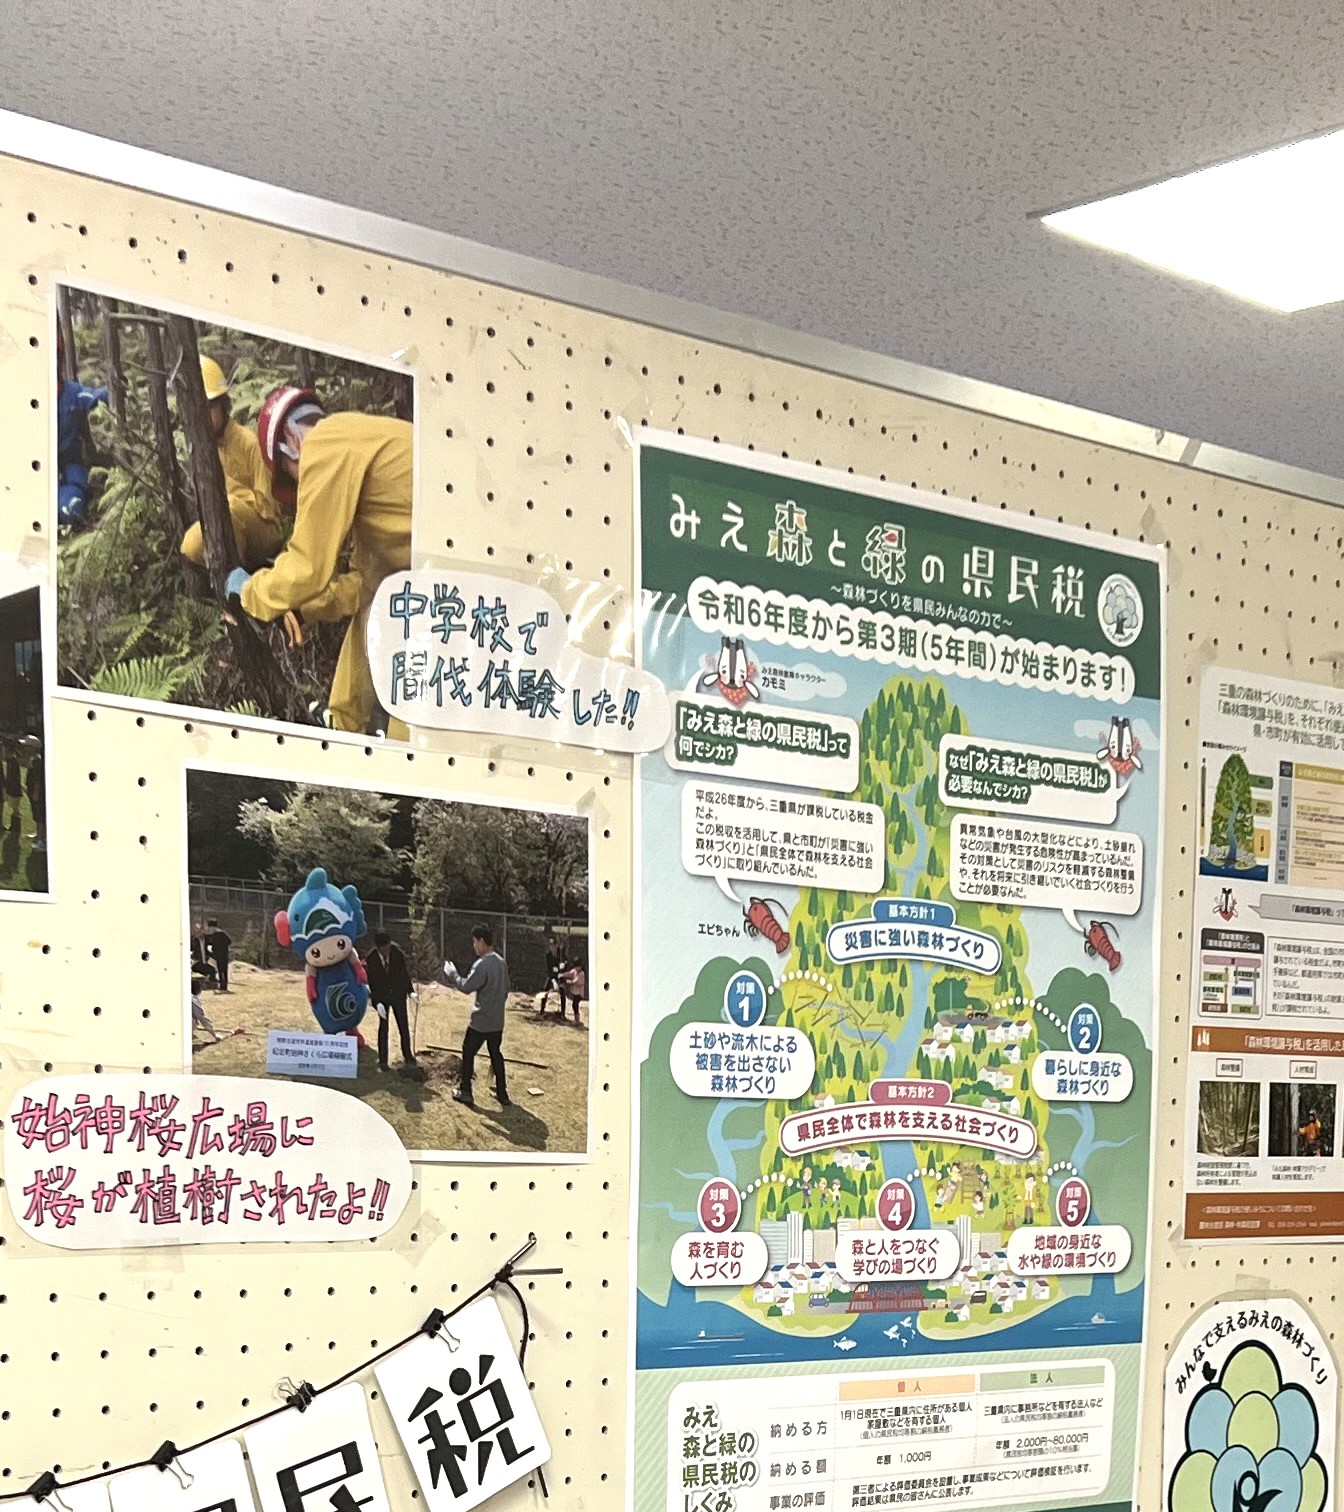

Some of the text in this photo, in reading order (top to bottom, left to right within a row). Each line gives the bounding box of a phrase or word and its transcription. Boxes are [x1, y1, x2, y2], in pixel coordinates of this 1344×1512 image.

[670, 494, 1087, 618] みえ森と緑の県民税
[390, 581, 548, 655] 中学校で
[679, 706, 847, 753] 「みえ森と緑の県民税」って
[949, 751, 1108, 788] なぜ「みえ森と緑の県民税」が
[695, 805, 718, 820] だよ。
[698, 923, 740, 937] エビちゃん
[845, 929, 984, 960] 災害に強い森林づくり
[739, 996, 749, 1021] 1
[690, 1031, 797, 1053] 土砂や流木による
[1079, 1027, 1091, 1048] 2
[696, 1052, 791, 1073] 被害を出さない
[1046, 1059, 1121, 1077] 暮らしに身近な
[711, 1075, 775, 1094] 森林づくり
[1057, 1079, 1109, 1095] 森林づくり
[11, 1091, 314, 1159] 始神桜広場に
[797, 1111, 1020, 1144] 県民全体で森林を支える社会づくり
[23, 1164, 390, 1228] 桜が植樹されたよ!!
[711, 1207, 726, 1227] 3
[888, 1209, 902, 1228] 4
[1067, 1201, 1078, 1221] 5
[688, 1241, 744, 1259] 森を育む
[852, 1239, 940, 1255] 森と人をつなぐ
[1035, 1234, 1102, 1250] 地域の身近な
[690, 1261, 742, 1279] 人づくり
[853, 1259, 937, 1276] 学びの場づくり
[1018, 1253, 1116, 1269] 水や緑の環境づくり
[1175, 1310, 1328, 1394] みんなで支えるみえの森林づくり
[683, 1405, 718, 1428] みえ
[771, 1421, 827, 1438] 納める方
[683, 1432, 755, 1458] 森と緑の
[683, 1461, 756, 1488] 県民税の
[770, 1459, 826, 1477] 納める額
[770, 1492, 825, 1510] 事業の評価
